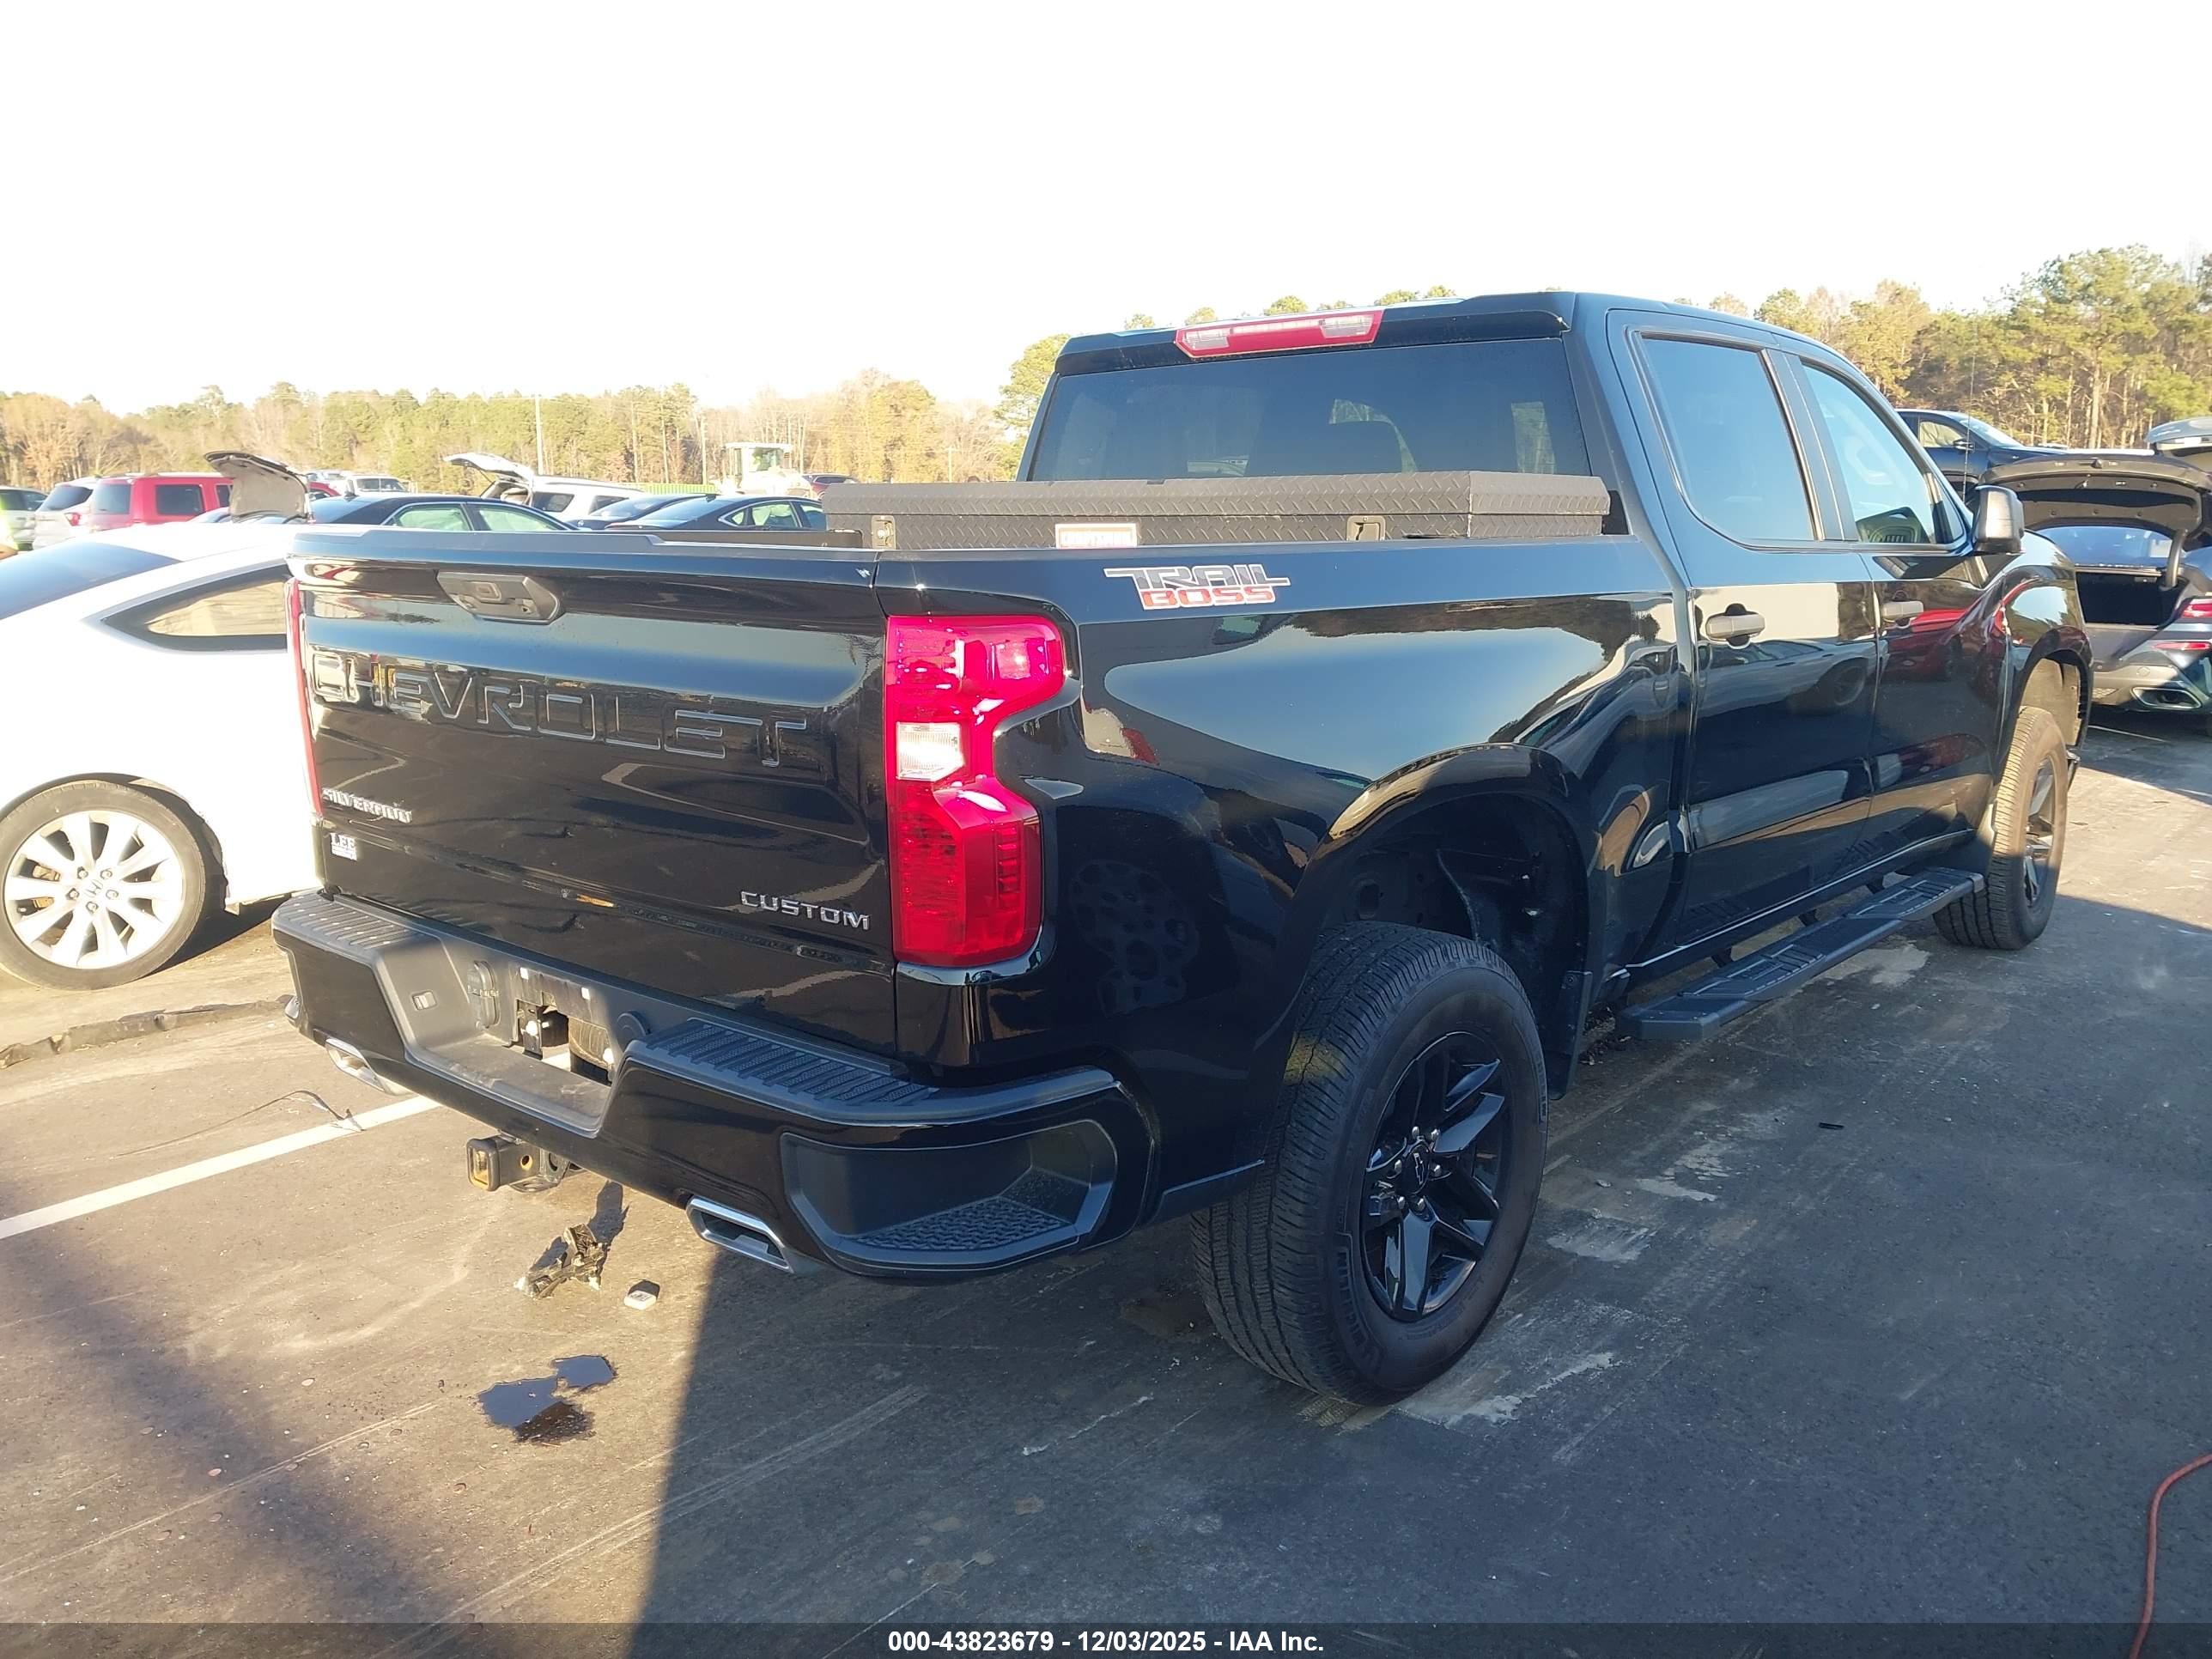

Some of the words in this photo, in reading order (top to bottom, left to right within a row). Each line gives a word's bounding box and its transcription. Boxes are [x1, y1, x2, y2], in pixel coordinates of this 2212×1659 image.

[1103, 563, 1291, 590] TRAIL
[1140, 585, 1276, 611] BOSS
[312, 649, 807, 768] CHEVROLET
[740, 890, 871, 931] CUSTOM
